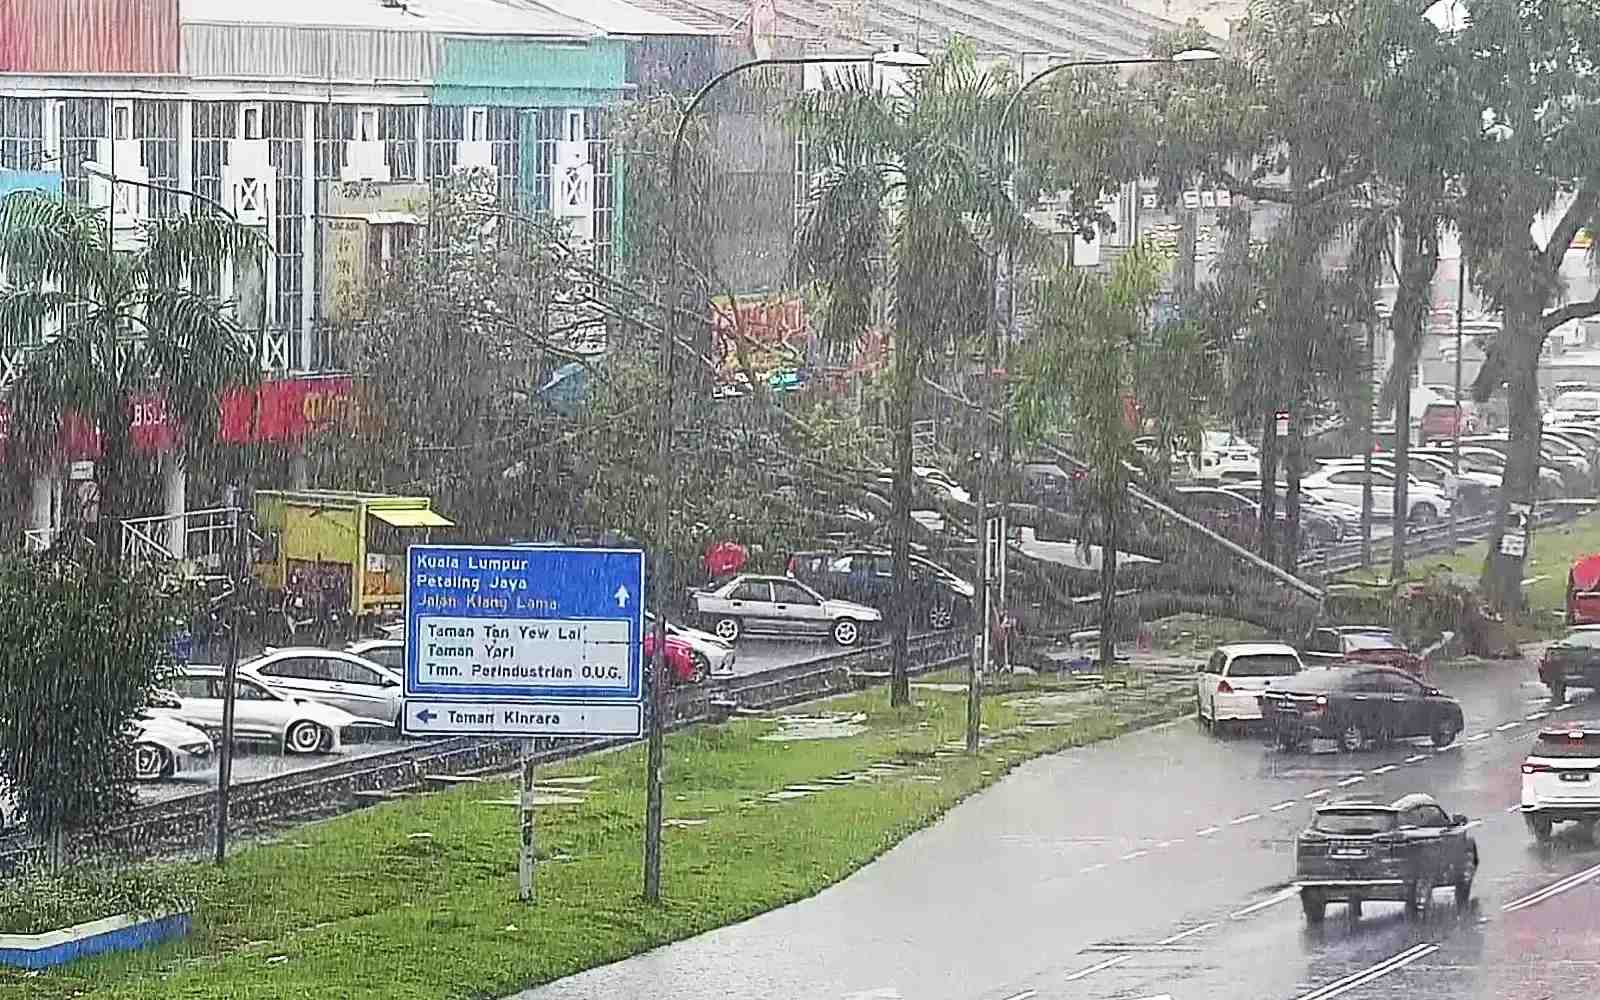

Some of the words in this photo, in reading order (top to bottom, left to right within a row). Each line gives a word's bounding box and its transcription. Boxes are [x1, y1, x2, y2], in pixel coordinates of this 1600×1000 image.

[417, 555, 459, 569] Kuala
[468, 556, 528, 572] Lumpur
[416, 574, 480, 592] Petaling
[490, 576, 527, 592] Jaya
[417, 593, 457, 609] Jalan
[466, 594, 508, 612] Klang
[516, 596, 558, 610] Lama
[428, 624, 474, 638] Taman
[483, 625, 509, 639] Tan
[519, 626, 549, 640] Yew
[558, 627, 581, 640] Lai
[428, 644, 474, 657] Taman
[427, 663, 463, 677] Tmn.
[471, 664, 573, 678] Perindustrian
[581, 665, 623, 680] O.U.G.
[448, 710, 494, 724] Taman
[504, 711, 560, 725] Kinrara
